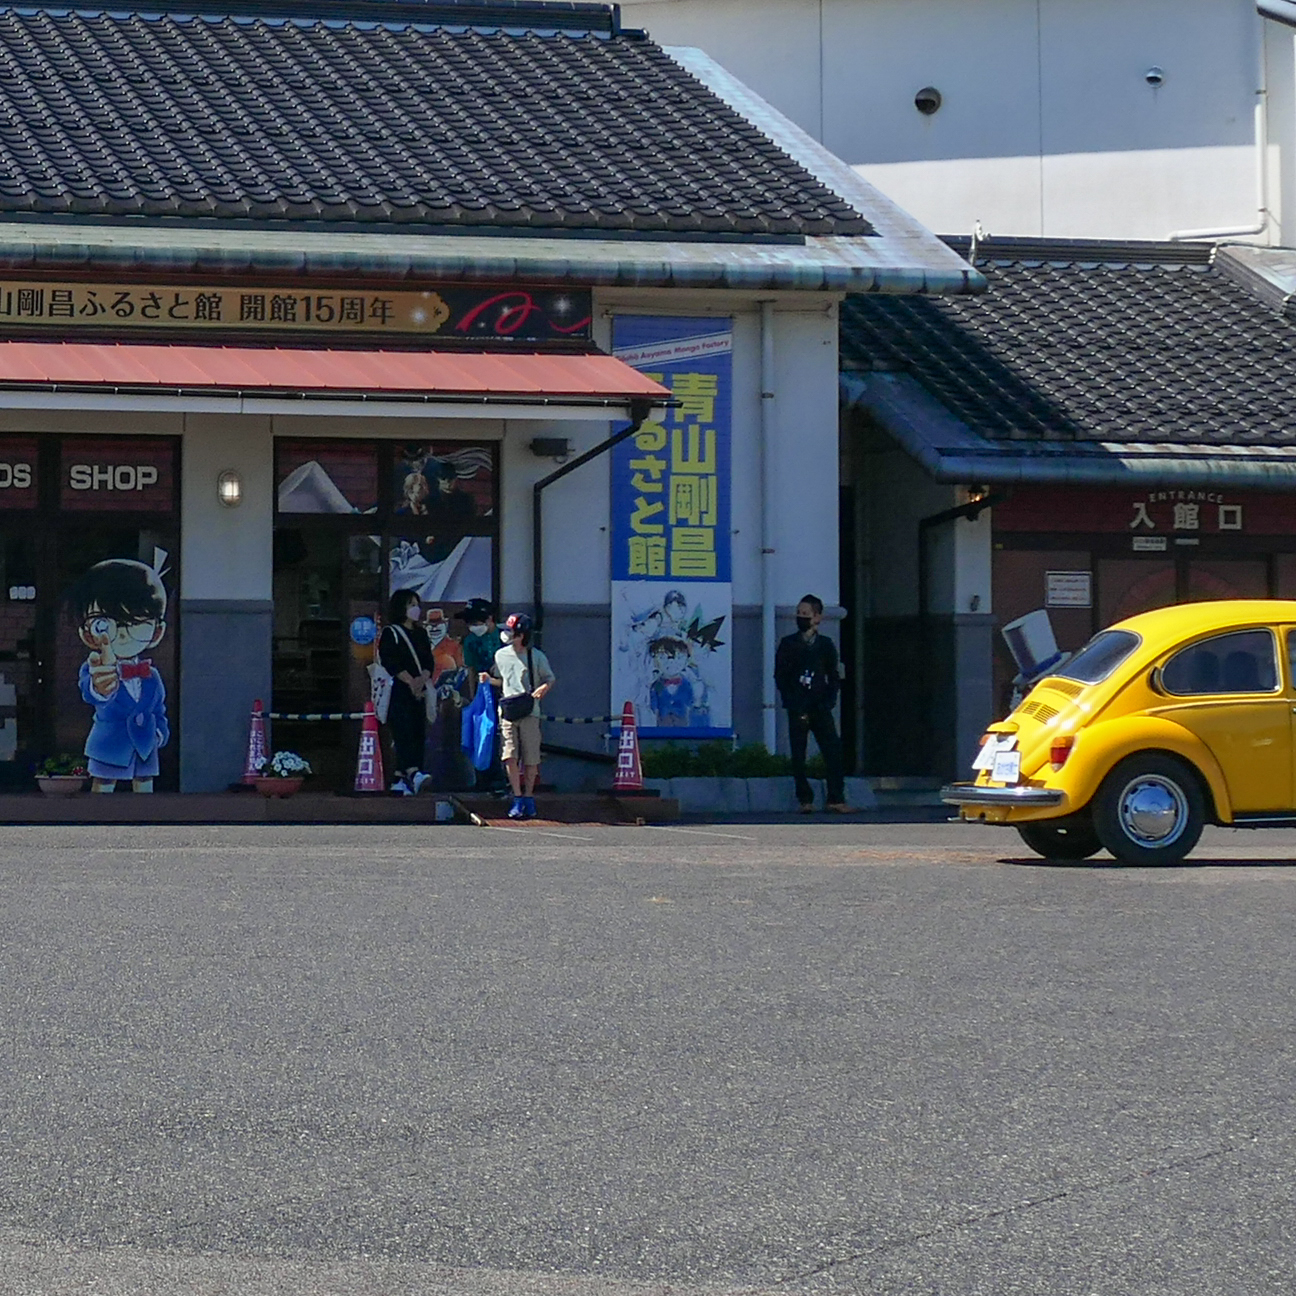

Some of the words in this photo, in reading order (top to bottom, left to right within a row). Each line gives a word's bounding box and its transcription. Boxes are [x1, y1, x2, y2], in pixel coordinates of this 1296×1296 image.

[239, 294, 396, 325] 開館15周年
[675, 344, 700, 354] Manga
[702, 340, 730, 350] Factory
[70, 464, 158, 490] SHOP
[628, 372, 668, 577] るさと館
[668, 372, 719, 577] 青山剛昌
[1149, 490, 1224, 504] ENTRANCE
[1129, 501, 1243, 530] 入館口
[358, 736, 375, 775] 出口
[618, 730, 634, 768] 出口
